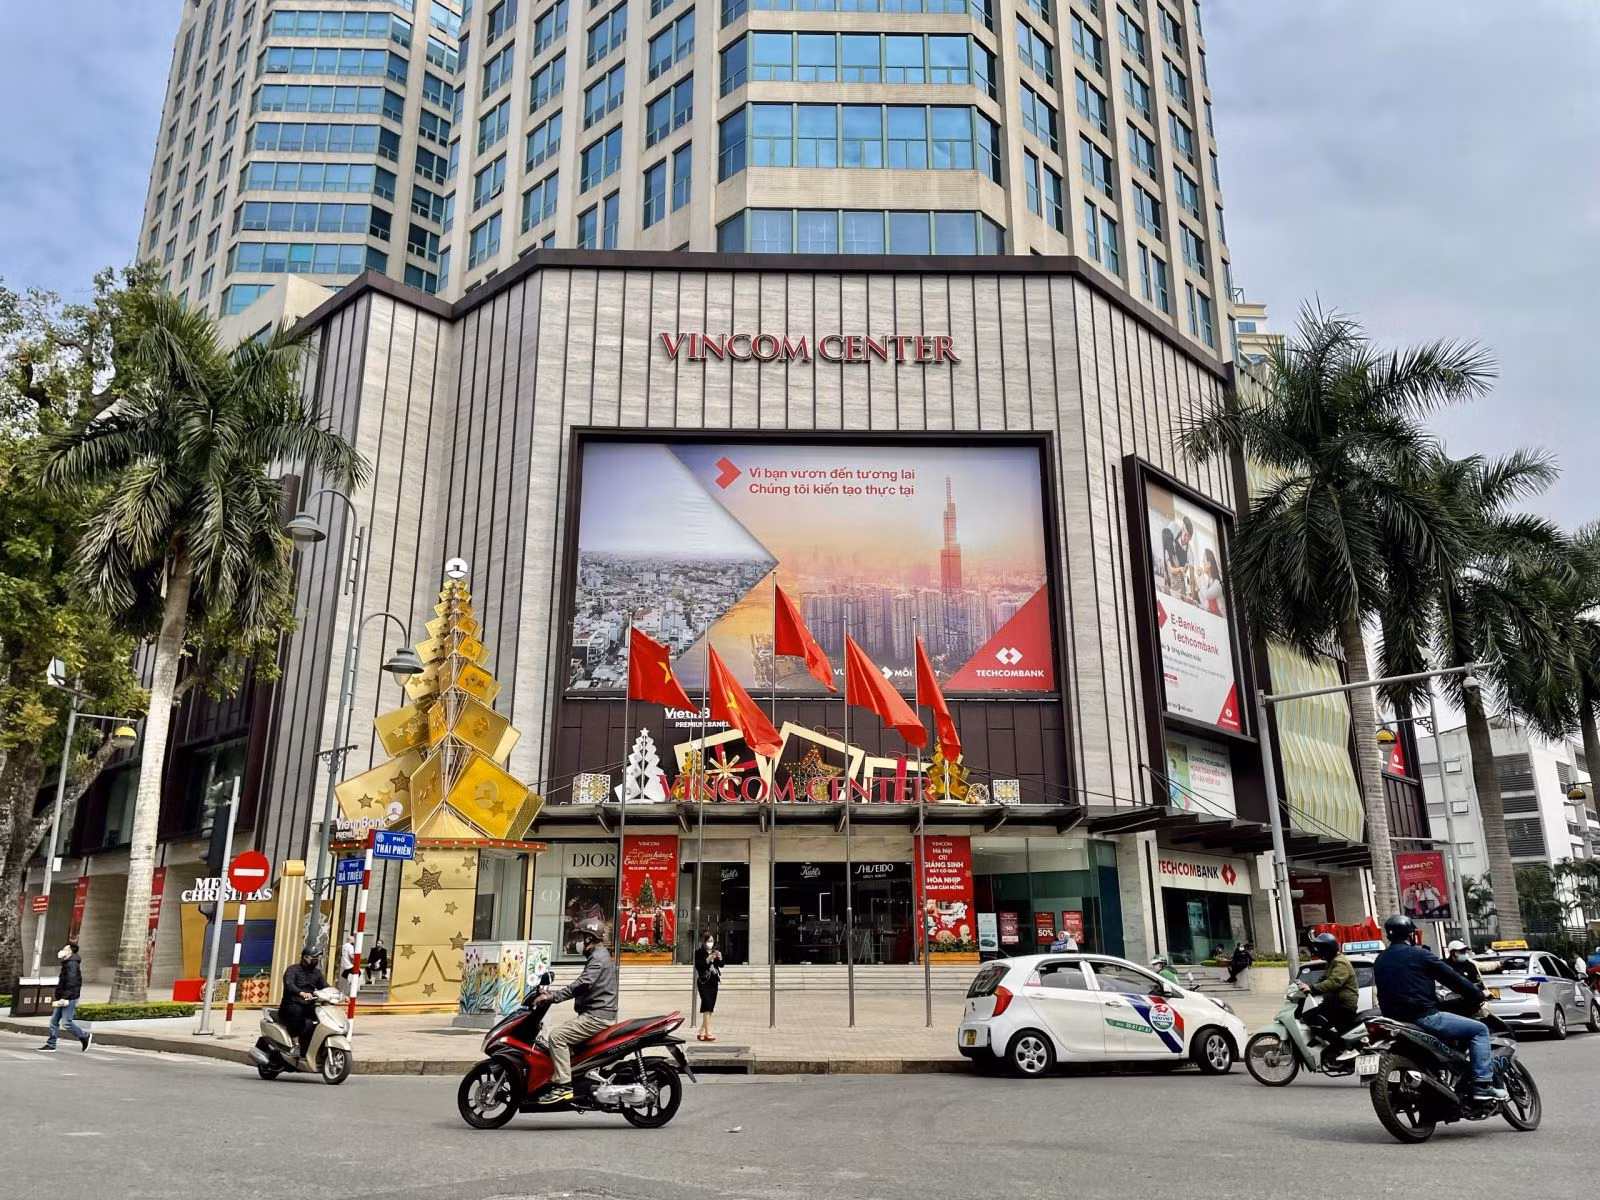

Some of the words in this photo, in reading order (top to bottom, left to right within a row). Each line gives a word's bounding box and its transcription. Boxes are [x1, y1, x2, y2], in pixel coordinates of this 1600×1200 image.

[659, 331, 812, 362] VINCOM
[818, 334, 962, 364] CENTER
[749, 467, 761, 479] Vì
[764, 468, 787, 481] bạn
[791, 469, 827, 479] vươn
[830, 466, 853, 479] đến
[856, 469, 898, 482] tương
[901, 469, 915, 480] lai
[749, 482, 791, 496] Chúng
[794, 483, 810, 495] tôi
[813, 482, 839, 495] kiến
[842, 485, 862, 497] tạo
[865, 484, 896, 498] thực
[900, 485, 914, 498] tại
[1171, 612, 1206, 640] E-Banking
[1172, 629, 1220, 656] Techcombank
[976, 669, 1045, 678] TECHCOMBANK
[657, 774, 800, 804] VINCOM
[806, 776, 938, 804] CENTER
[335, 815, 387, 831] VietinBank
[376, 843, 391, 855] THÁI
[392, 844, 412, 856] PHIÊN
[571, 852, 616, 868] DIOR
[800, 865, 821, 879] Kiehl's
[854, 863, 894, 875] SHISEIDO
[1037, 929, 1054, 937] 50%
